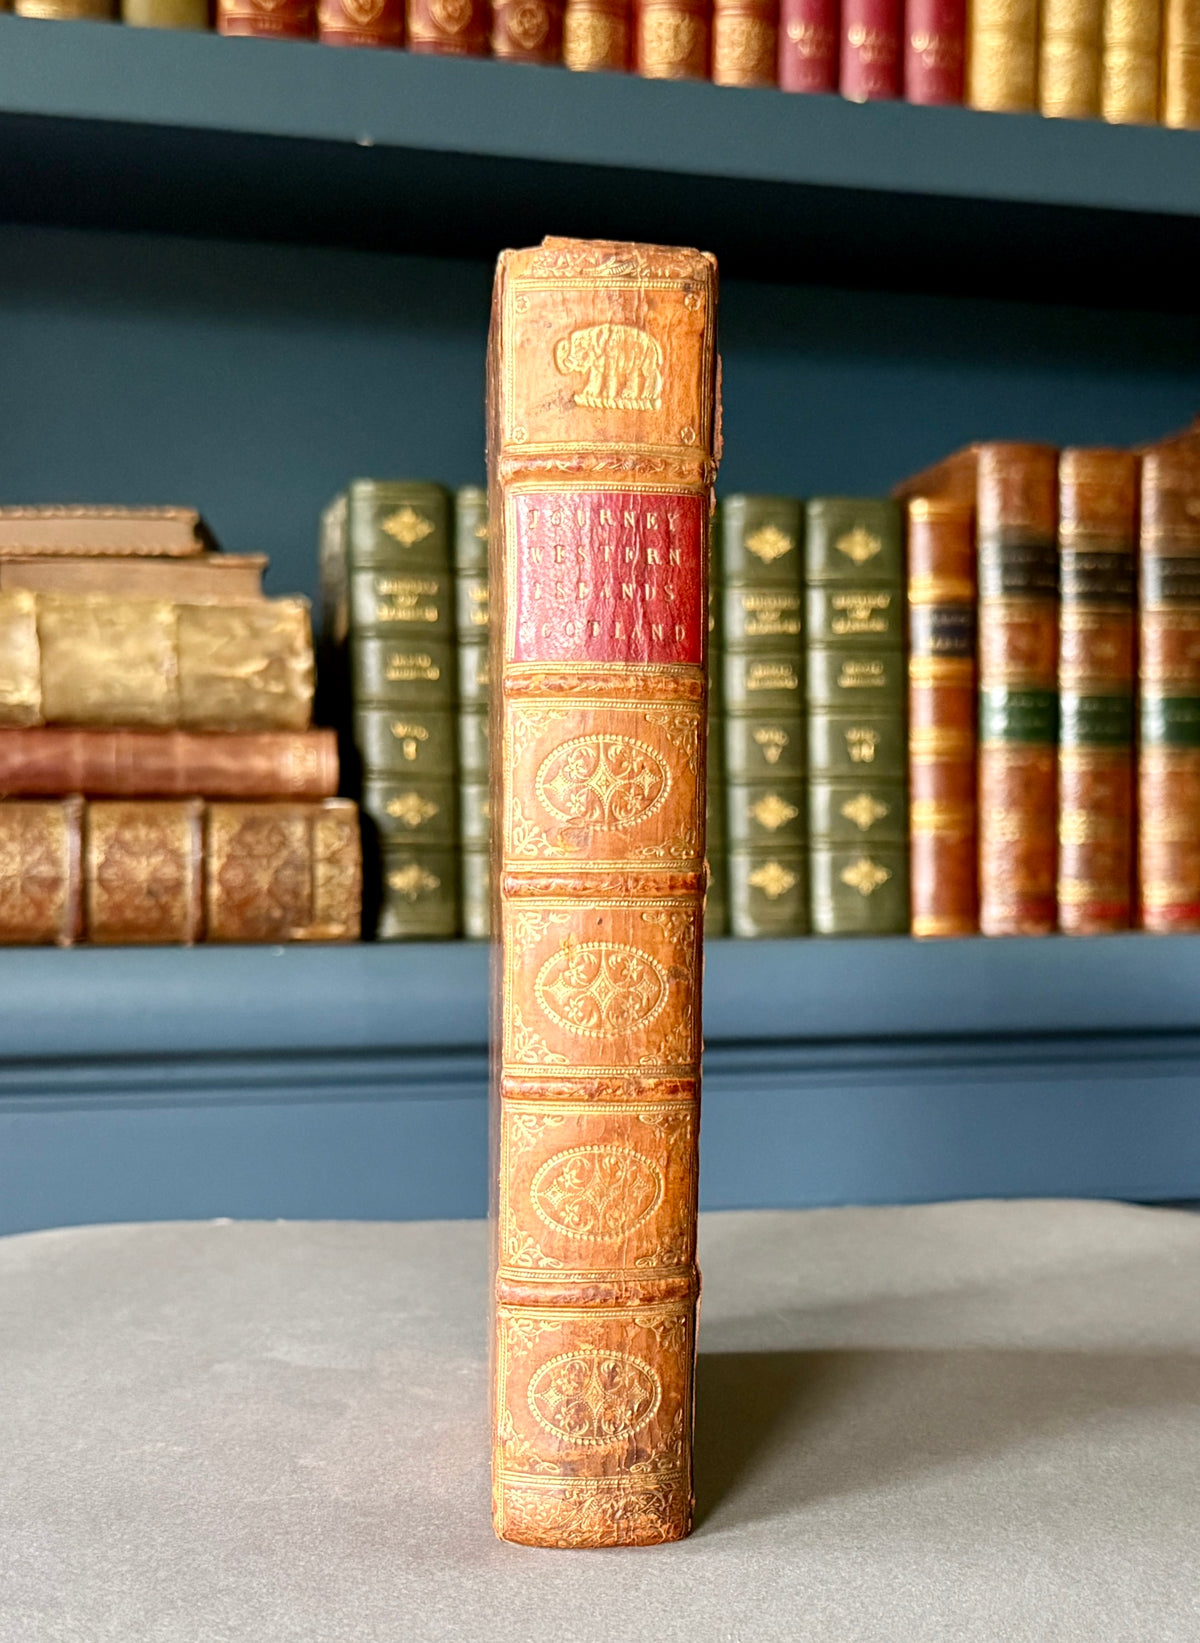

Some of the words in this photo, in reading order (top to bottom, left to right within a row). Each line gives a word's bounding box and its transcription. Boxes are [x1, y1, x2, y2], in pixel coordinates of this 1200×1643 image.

[529, 509, 679, 531] JOURNEY
[529, 545, 681, 566] WESTERN
[533, 581, 675, 601] ISLANDS
[520, 620, 685, 641] SCOTLAND
